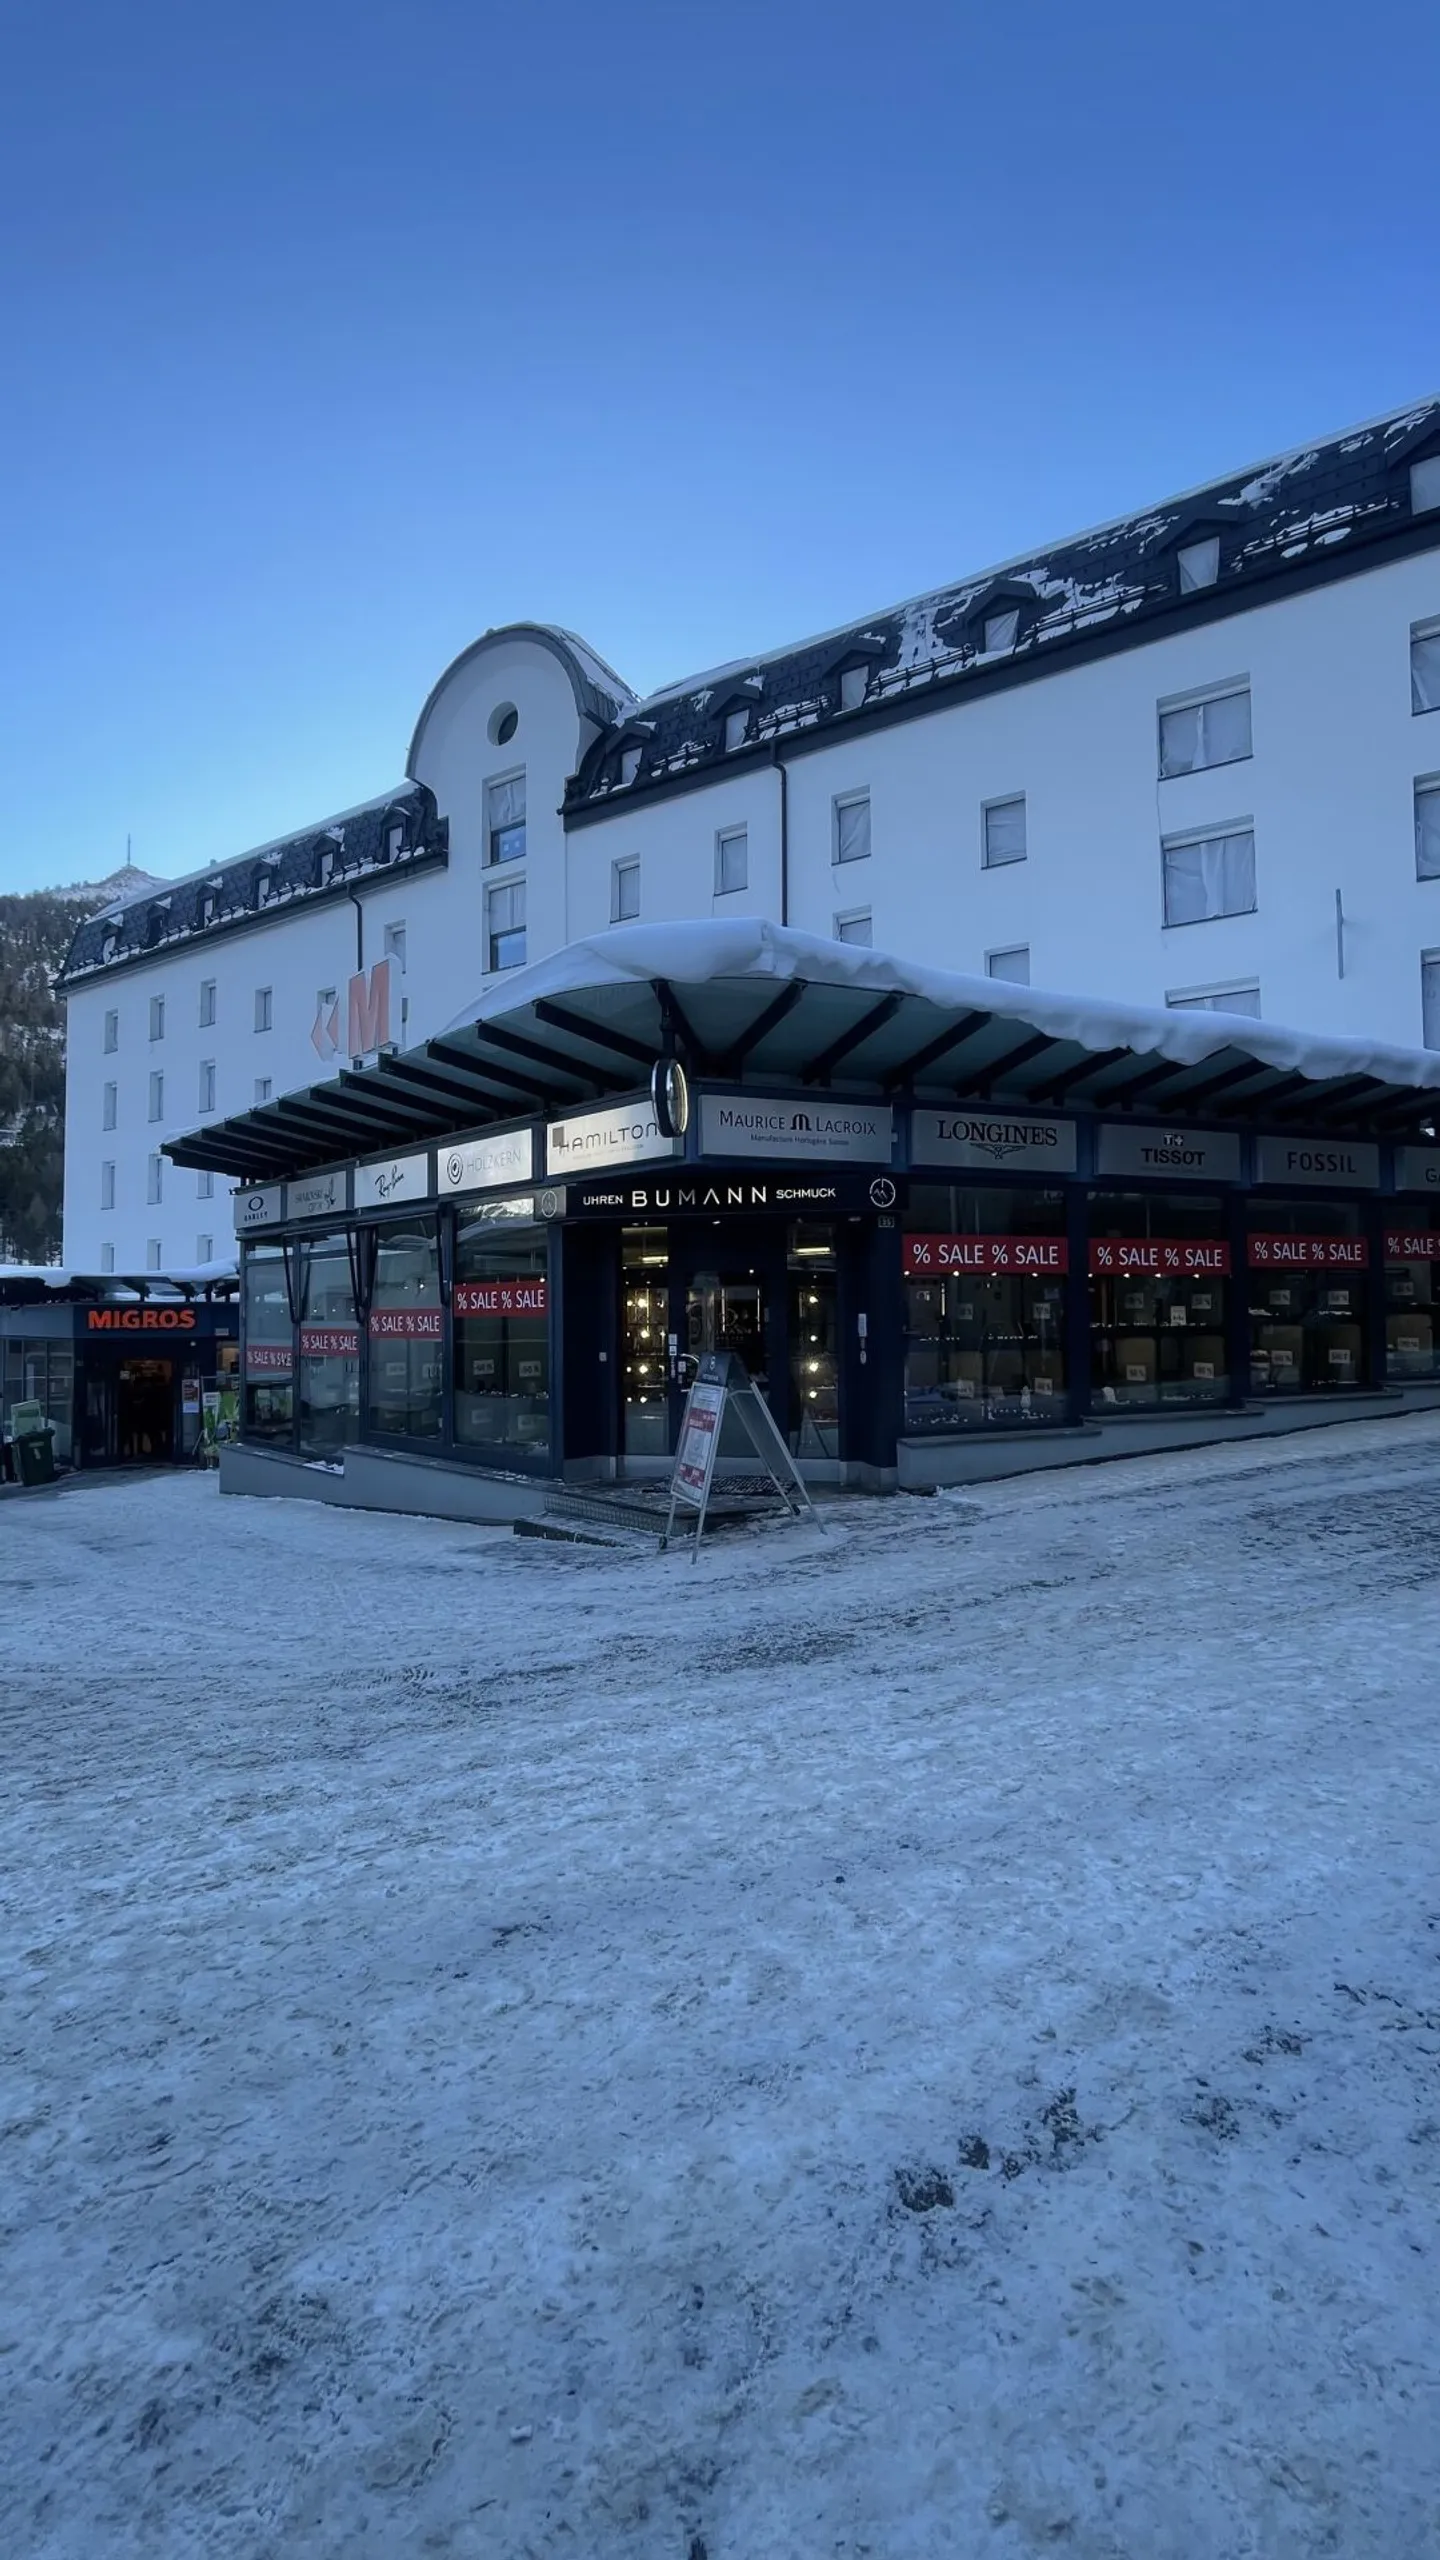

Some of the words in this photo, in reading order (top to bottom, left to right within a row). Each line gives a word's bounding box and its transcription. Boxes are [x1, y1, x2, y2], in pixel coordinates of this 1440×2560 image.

[348, 959, 390, 1059] M
[557, 1122, 658, 1155] HAMILTON
[937, 1120, 1057, 1146] LONGINES
[467, 1149, 522, 1174] HOLZKERN
[1140, 1148, 1206, 1166] TISSOT
[1287, 1151, 1357, 1174] FOSSIL
[1425, 1168, 1440, 1184] G
[583, 1194, 623, 1206] UHREN
[631, 1186, 767, 1208] BUMANN
[776, 1187, 837, 1199] SCHMUCK
[913, 1244, 931, 1264] %
[938, 1244, 985, 1264] SALE
[991, 1245, 1008, 1265] %
[1015, 1246, 1059, 1265] SALE
[1097, 1246, 1112, 1266] %
[1118, 1247, 1159, 1267] SALE
[1164, 1248, 1180, 1267] %
[1185, 1249, 1223, 1267] SALE
[1255, 1241, 1268, 1259] %
[1273, 1242, 1307, 1260] SALE
[1312, 1243, 1325, 1260] %
[1329, 1244, 1362, 1261] SALE
[1387, 1237, 1400, 1254] %
[1403, 1238, 1435, 1255] SALE
[457, 1293, 468, 1310] %
[471, 1291, 498, 1310] SALE
[501, 1291, 512, 1309] %
[516, 1289, 545, 1308] SALE
[88, 1309, 196, 1329] MIGROS
[370, 1316, 380, 1332] %
[382, 1316, 404, 1332] SALE
[405, 1316, 415, 1332] %
[417, 1315, 440, 1332] SALE
[302, 1335, 309, 1349] %
[310, 1335, 329, 1350] SALE
[330, 1335, 338, 1350] %
[339, 1336, 358, 1351] SALE
[254, 1351, 269, 1365] SALE
